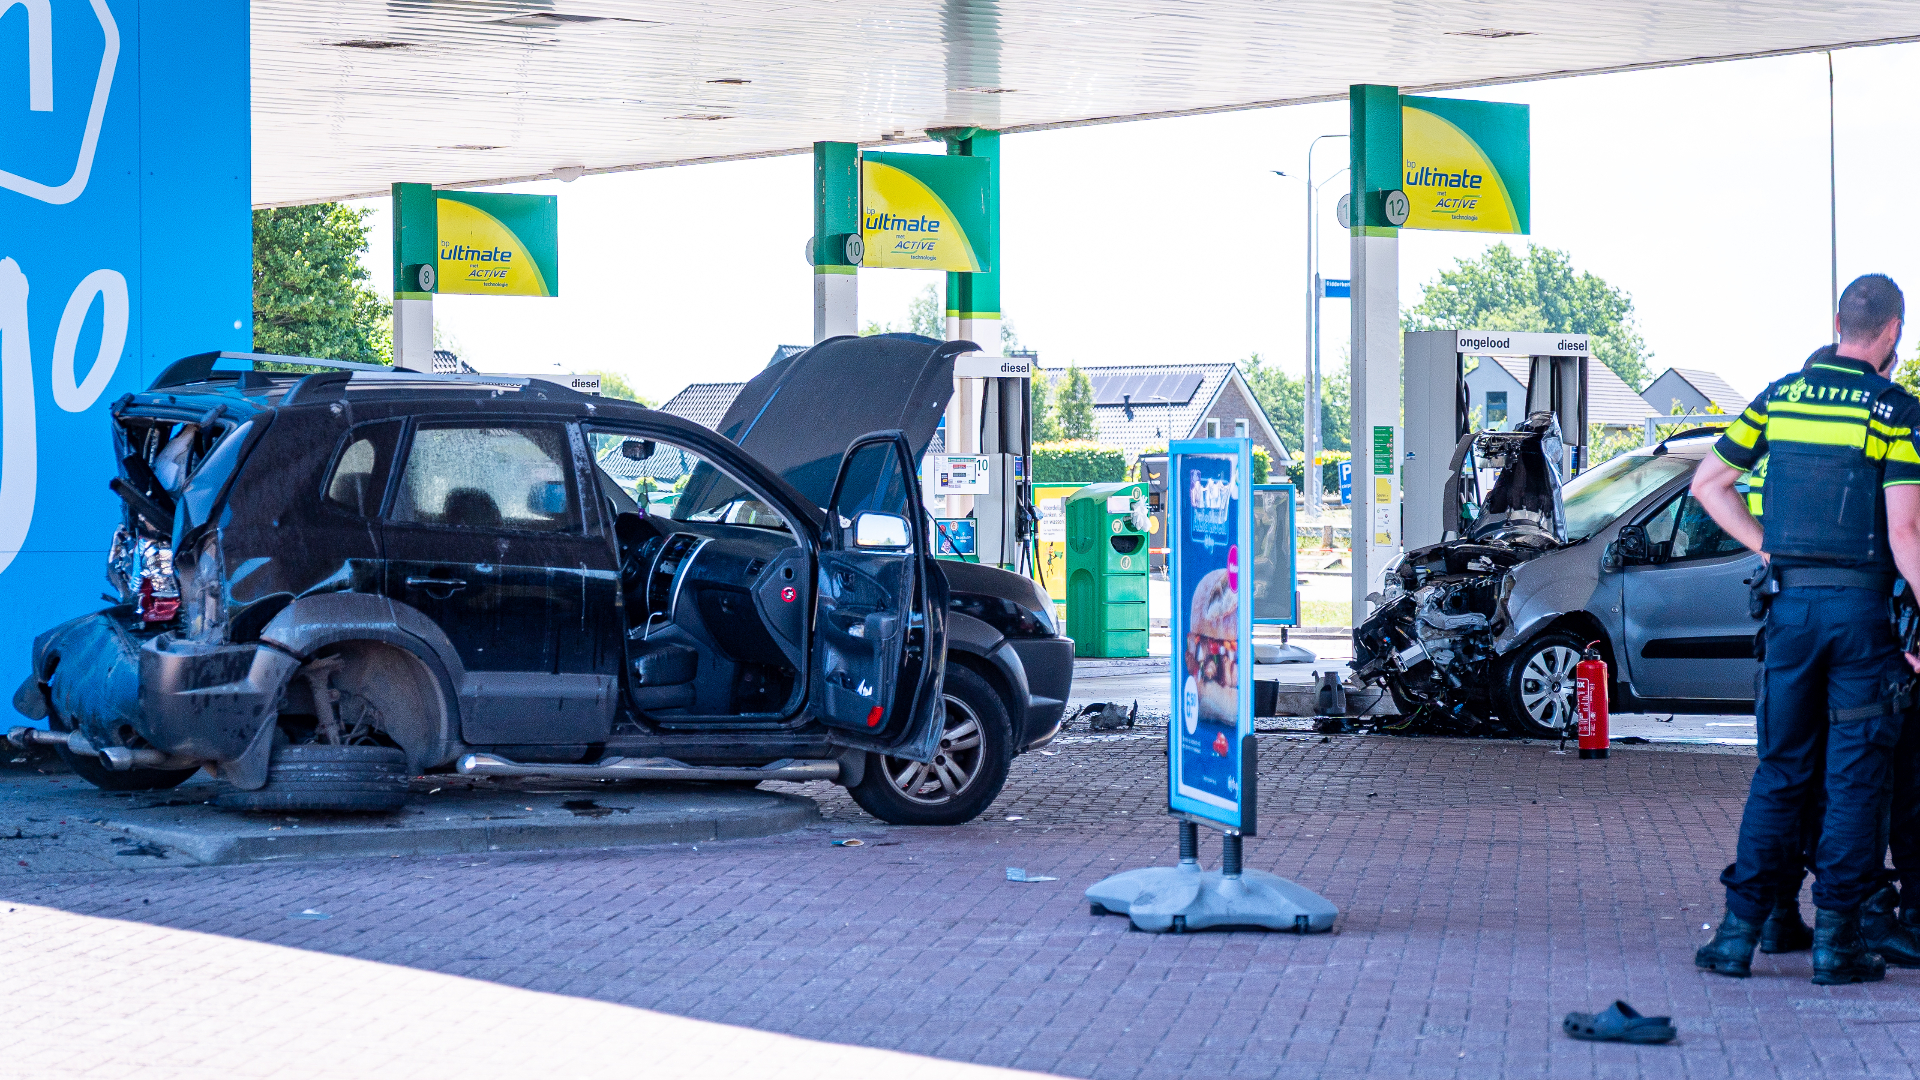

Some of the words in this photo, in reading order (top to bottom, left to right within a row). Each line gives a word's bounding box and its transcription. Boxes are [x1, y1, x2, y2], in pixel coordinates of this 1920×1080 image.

[1406, 159, 1416, 169] bp
[1406, 166, 1482, 189] ultimate
[1389, 198, 1405, 216] 12
[1435, 198, 1478, 209] ACTIVE
[866, 206, 876, 216] bp
[865, 213, 940, 233] ultimate
[440, 239, 450, 247] bp
[848, 239, 861, 257] 10
[895, 240, 936, 251] ACTIVE
[440, 245, 512, 262] ultimate
[423, 270, 430, 285] 8
[468, 269, 508, 278] ACTIVE
[1459, 336, 1510, 350] ongelood
[1557, 339, 1588, 351] diesel
[1000, 362, 1030, 373] diesel
[571, 378, 600, 388] diesel
[1779, 380, 1863, 402] POLITIE
[976, 459, 989, 471] 10
